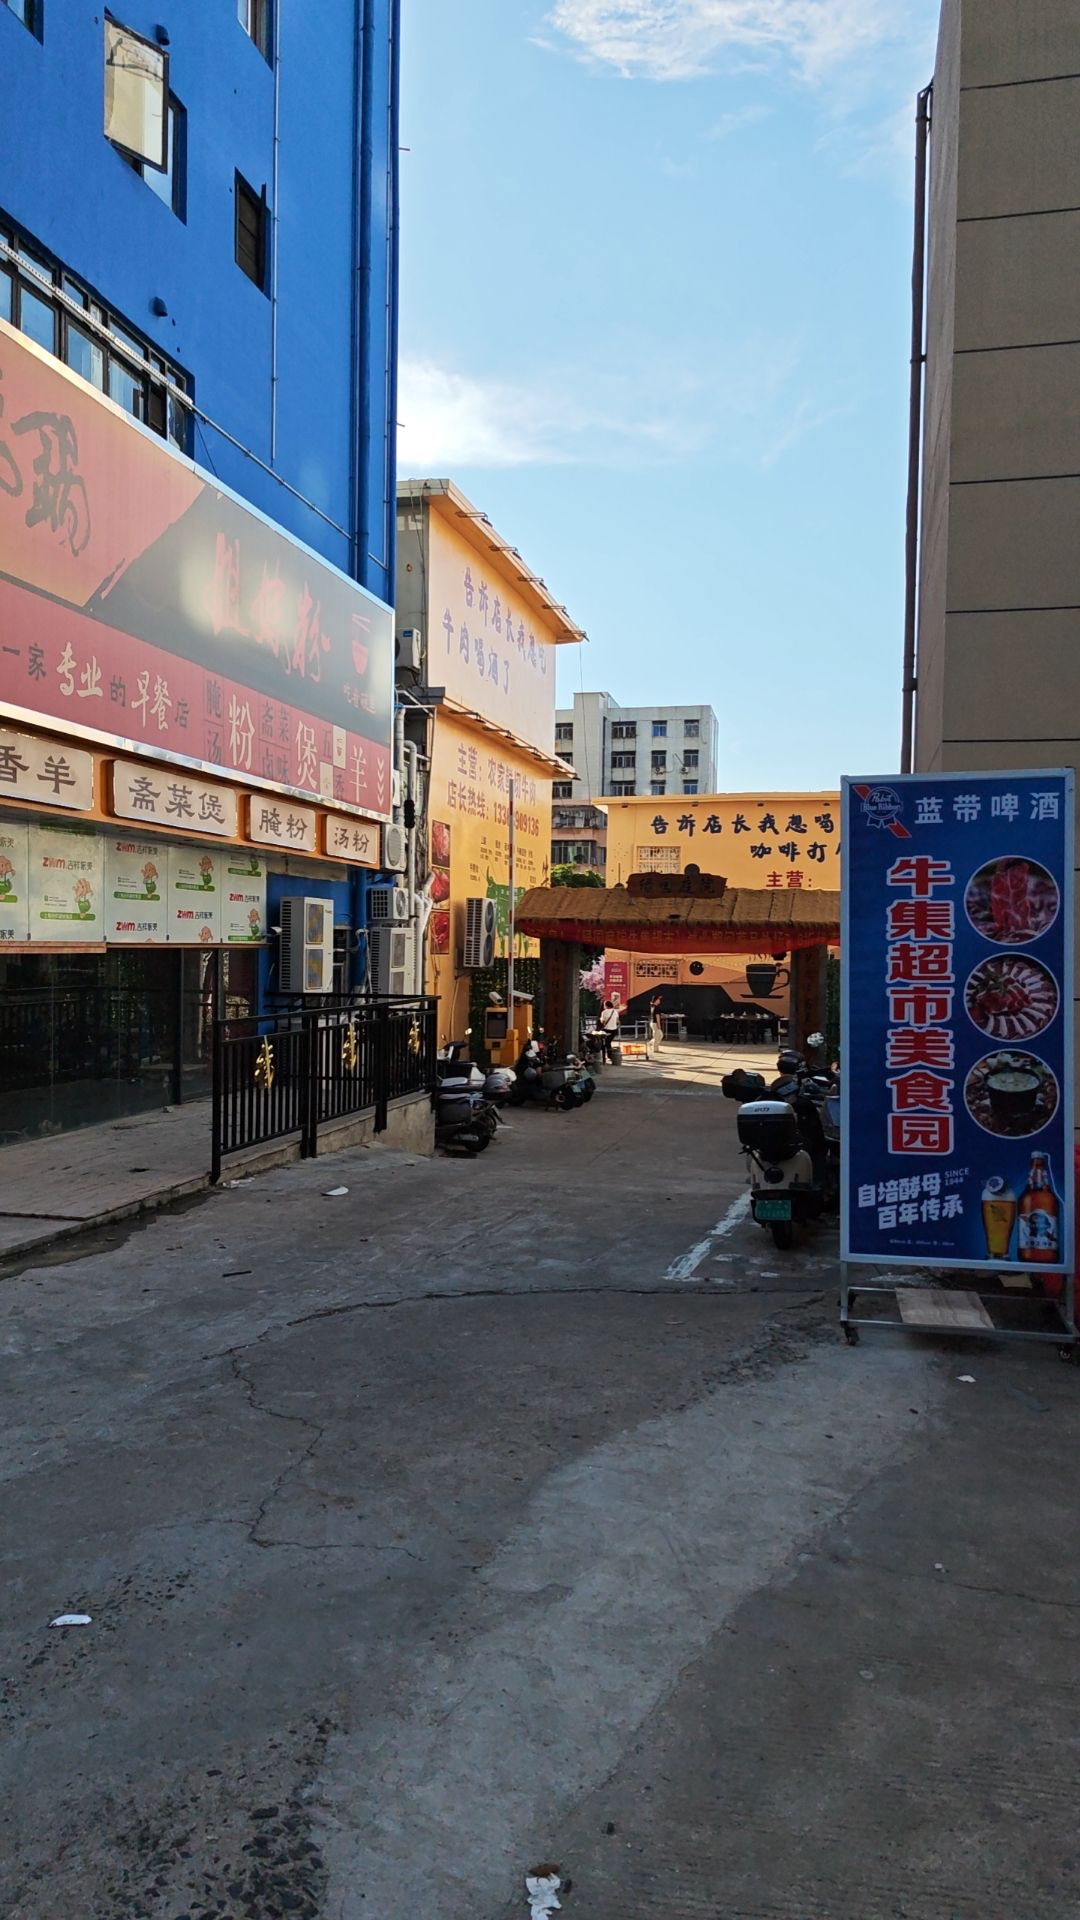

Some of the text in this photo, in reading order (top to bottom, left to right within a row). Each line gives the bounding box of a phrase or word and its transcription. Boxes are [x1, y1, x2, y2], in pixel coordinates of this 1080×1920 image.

[463, 566, 547, 676] 告诉店长我想吃
[442, 607, 510, 695] 牛肉喝酒了
[2, 641, 190, 731] 一家专业的早餐店
[0, 745, 76, 795] 香羊
[128, 776, 226, 825] 斋菜煲
[914, 792, 1060, 825] 蓝带啤酒
[259, 808, 308, 841] 腌粉
[334, 827, 370, 853] 汤粉
[651, 813, 835, 838] 告诉店长我想喝
[885, 855, 955, 1156] 牛集超市美食园
[858, 1172, 942, 1208] 自培酵母
[944, 1167, 970, 1178] SINCE
[877, 1193, 964, 1230] 百年传承
